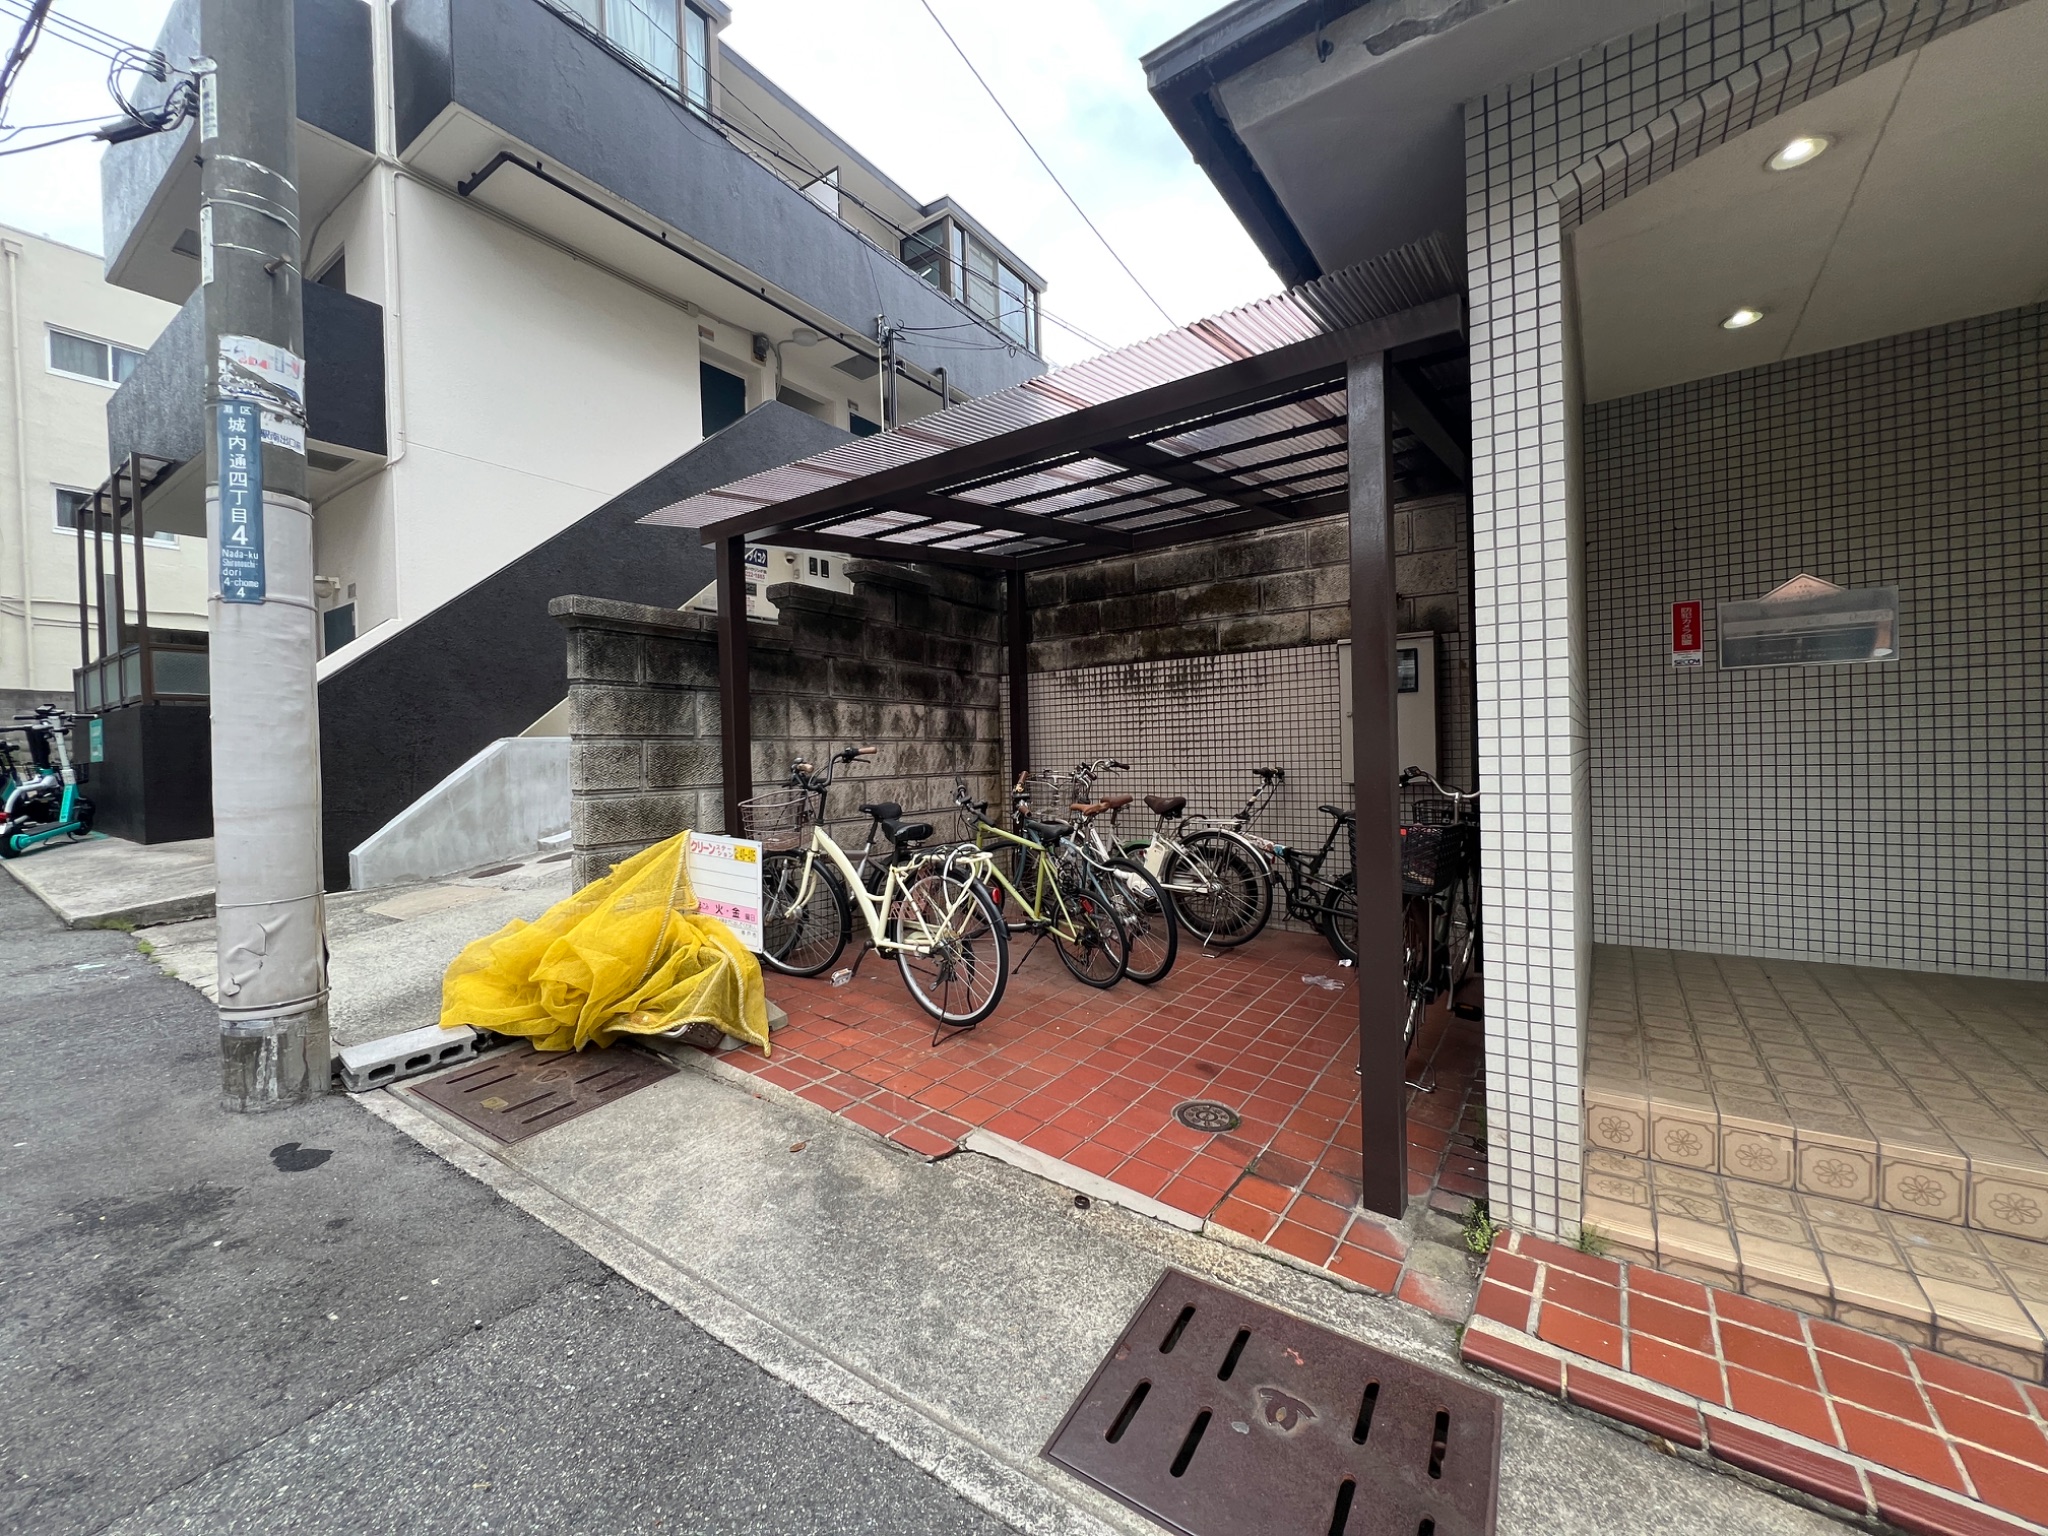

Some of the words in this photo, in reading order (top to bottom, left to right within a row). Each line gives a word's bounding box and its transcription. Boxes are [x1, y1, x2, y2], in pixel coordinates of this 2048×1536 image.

[222, 549, 259, 560] Nada-ku
[222, 567, 242, 577] dori
[223, 577, 260, 588] 4-chome
[236, 586, 246, 598] 4
[691, 840, 716, 854] クリーン
